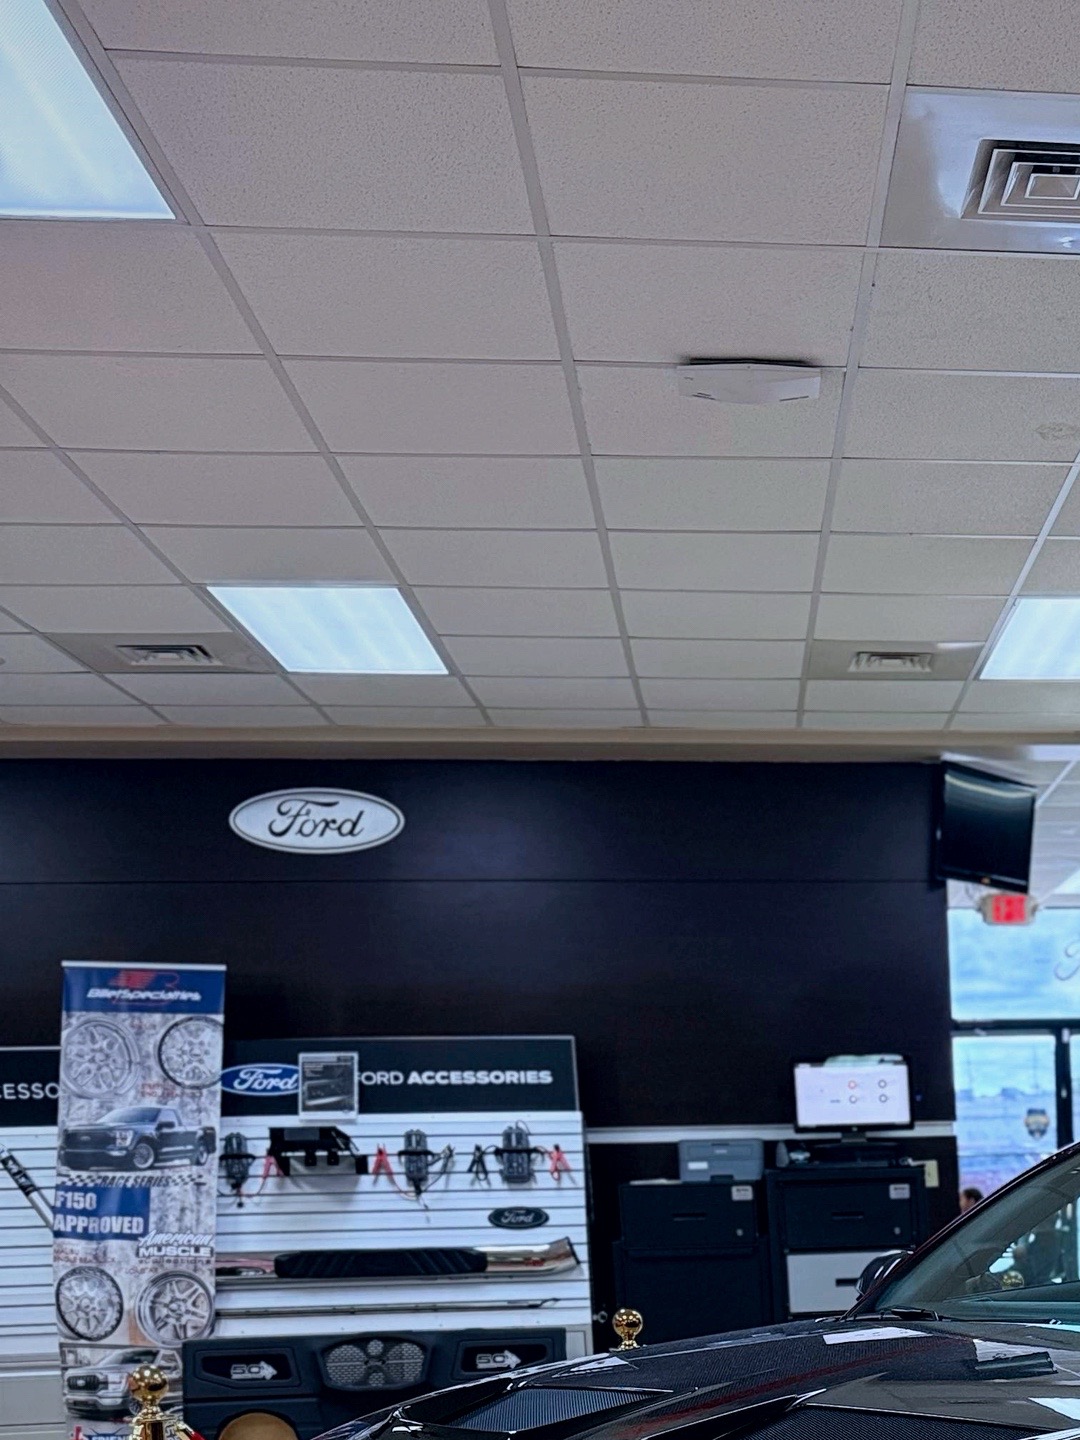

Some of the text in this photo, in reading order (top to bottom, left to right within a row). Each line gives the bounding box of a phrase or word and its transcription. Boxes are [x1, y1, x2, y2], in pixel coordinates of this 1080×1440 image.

[268, 798, 364, 838] Ford
[233, 1067, 299, 1091] Ford
[407, 1070, 554, 1085] ACCESSORIES
[101, 1175, 173, 1188] RACE SERIES
[55, 1190, 98, 1210] F150
[53, 1213, 145, 1235] APPROVED
[500, 1208, 536, 1224] Ford
[138, 1229, 213, 1247] American
[138, 1246, 212, 1257] MUSCLE
